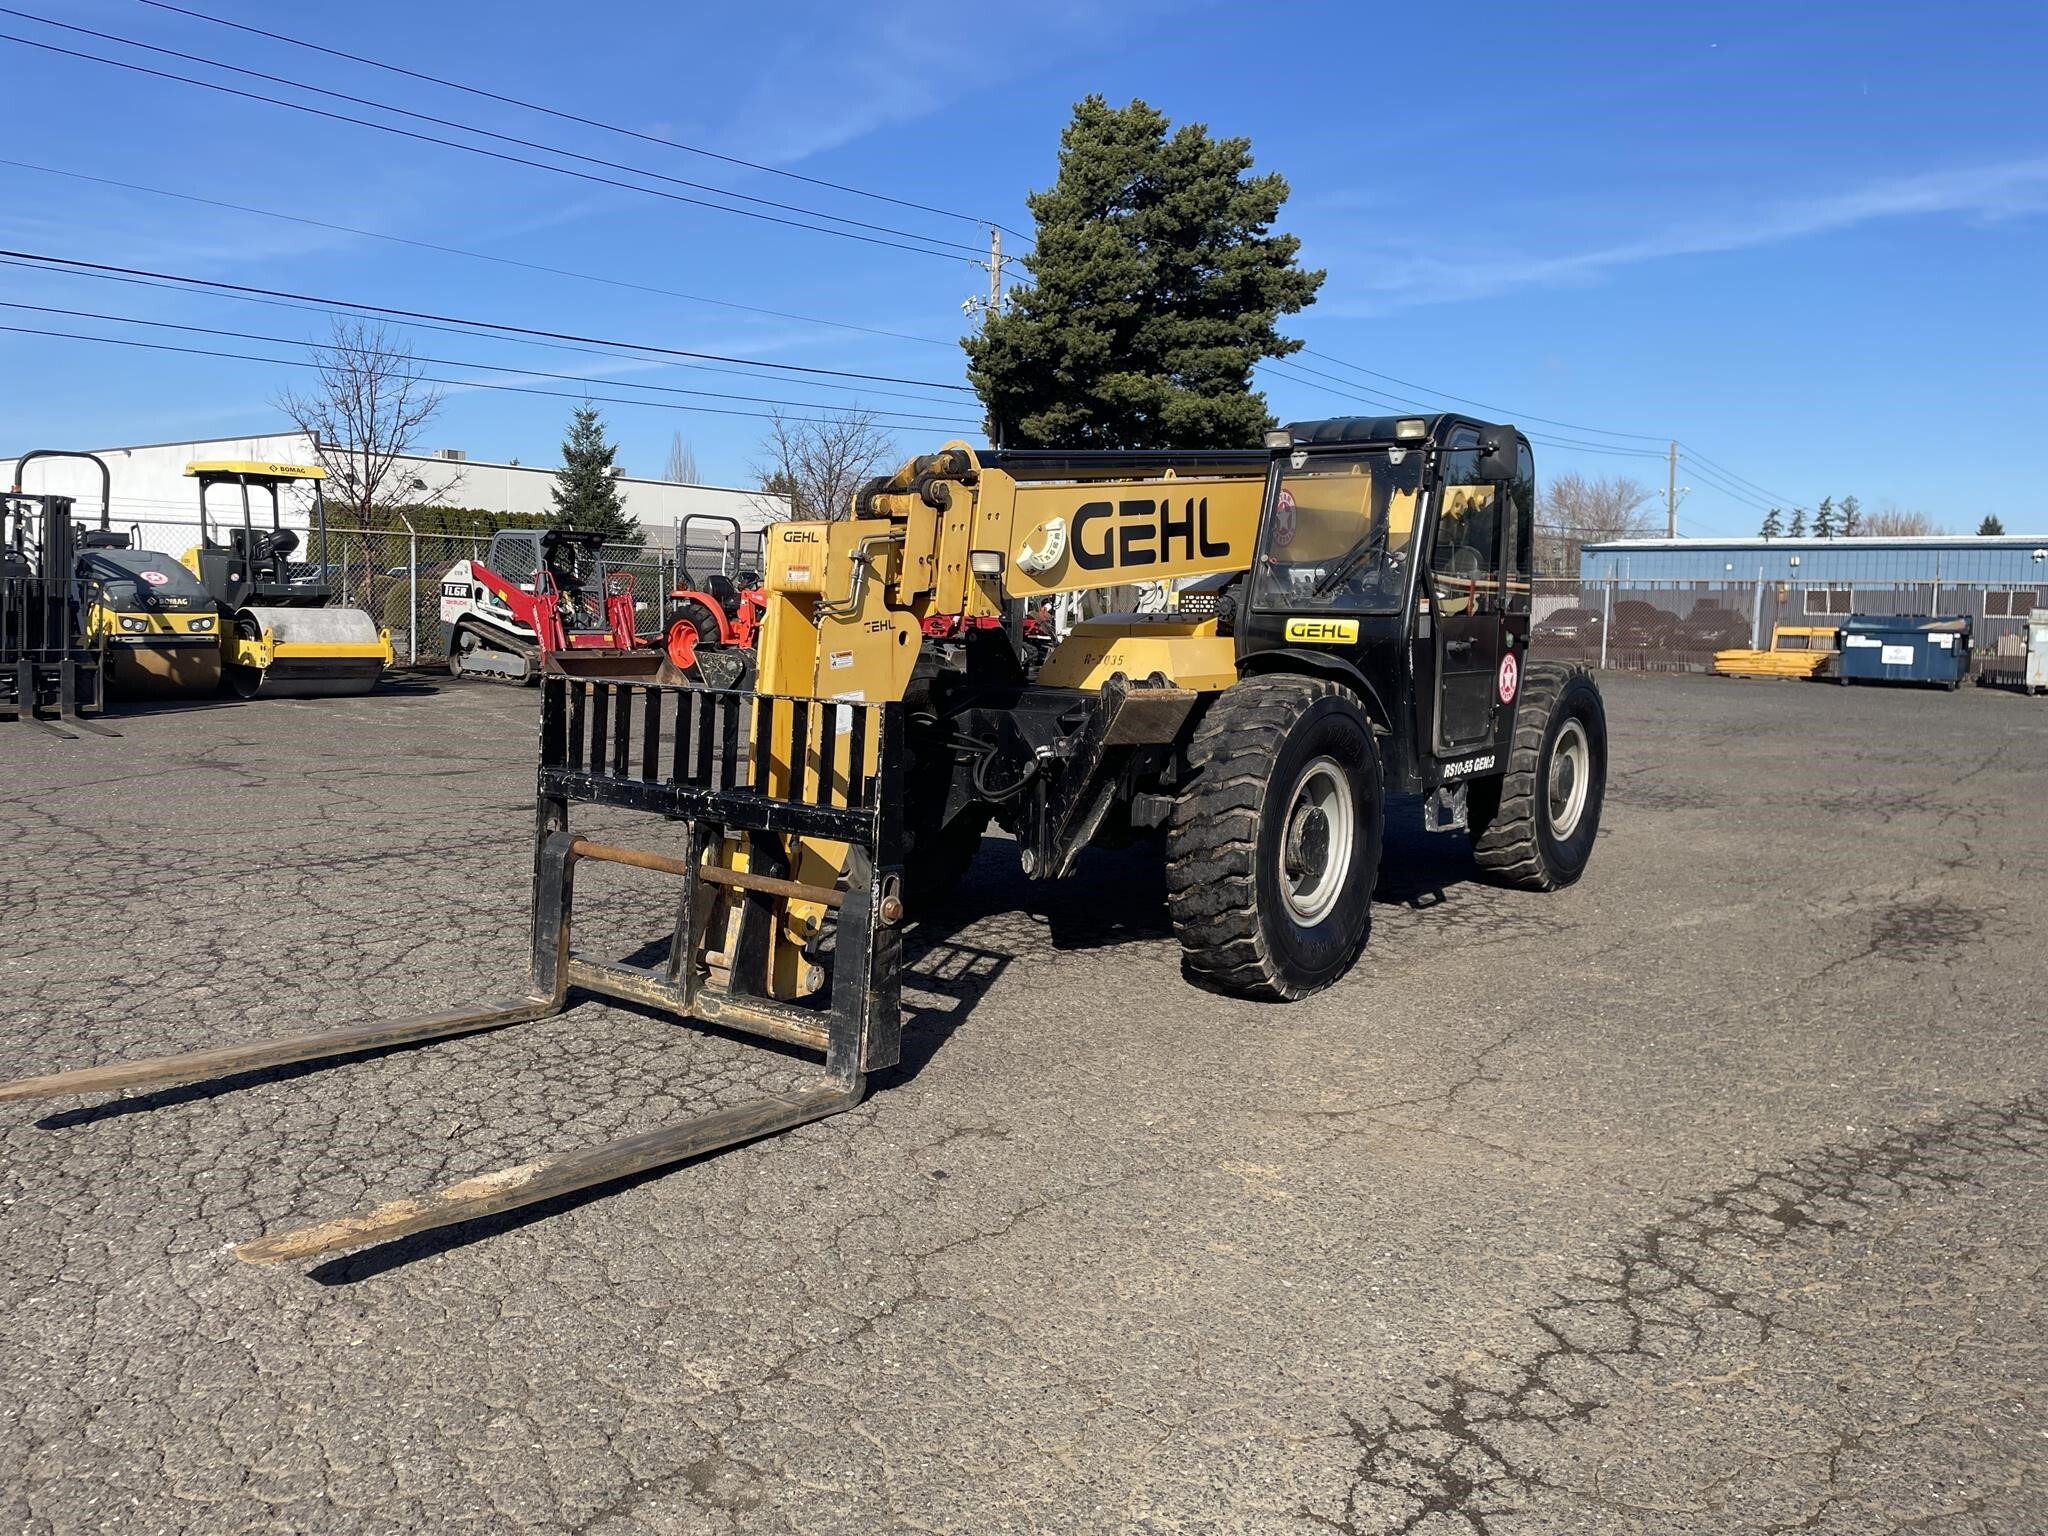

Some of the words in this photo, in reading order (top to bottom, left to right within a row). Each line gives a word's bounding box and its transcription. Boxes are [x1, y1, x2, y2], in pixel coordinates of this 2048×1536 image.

[280, 466, 306, 474] BOMAG
[783, 531, 819, 543] GEHL
[1071, 497, 1230, 570] GEHL
[443, 584, 469, 597] TL6R
[158, 598, 188, 606] BOMAG
[1291, 623, 1351, 639] GEHL
[1443, 760, 1473, 778] RS10-55
